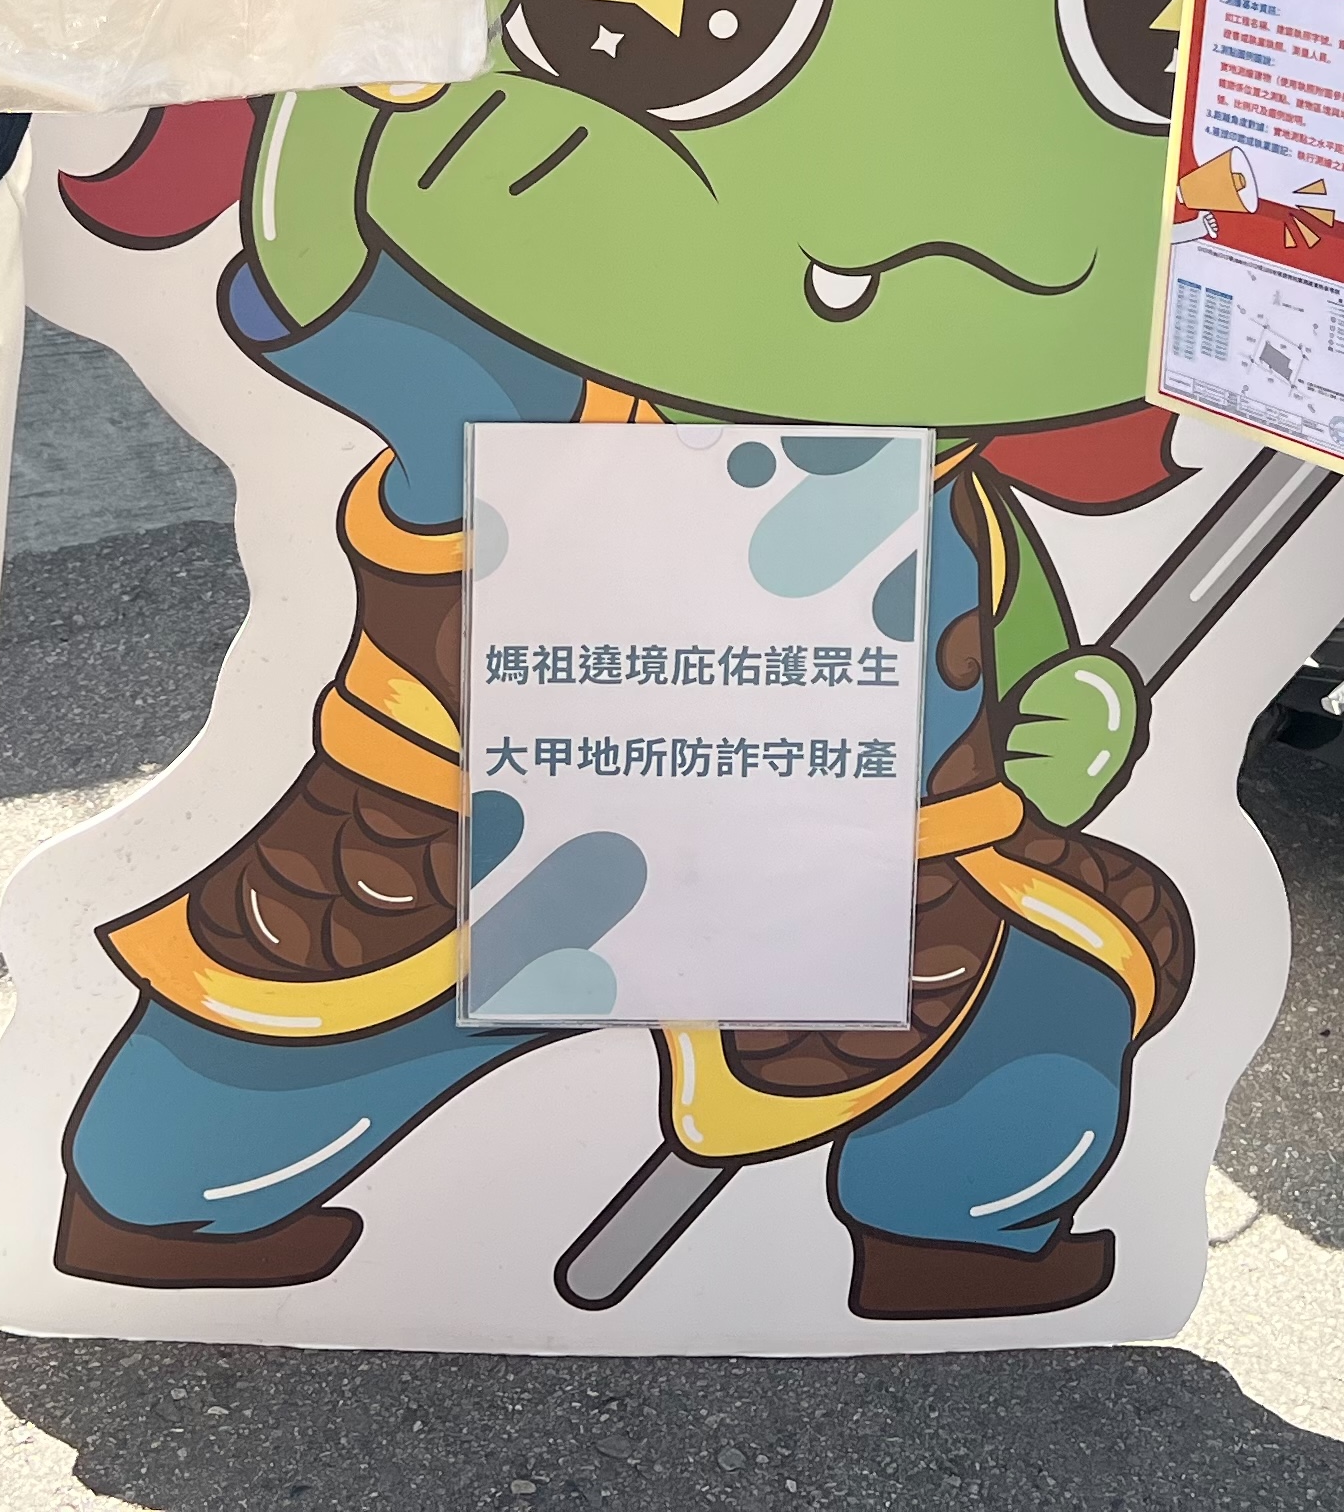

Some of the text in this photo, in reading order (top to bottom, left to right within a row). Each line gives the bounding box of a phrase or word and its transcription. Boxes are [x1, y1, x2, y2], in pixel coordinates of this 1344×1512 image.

[485, 644, 900, 688] 媽祖遶境庇佑護眾生
[485, 736, 898, 779] 大甲地所防詐守財產
